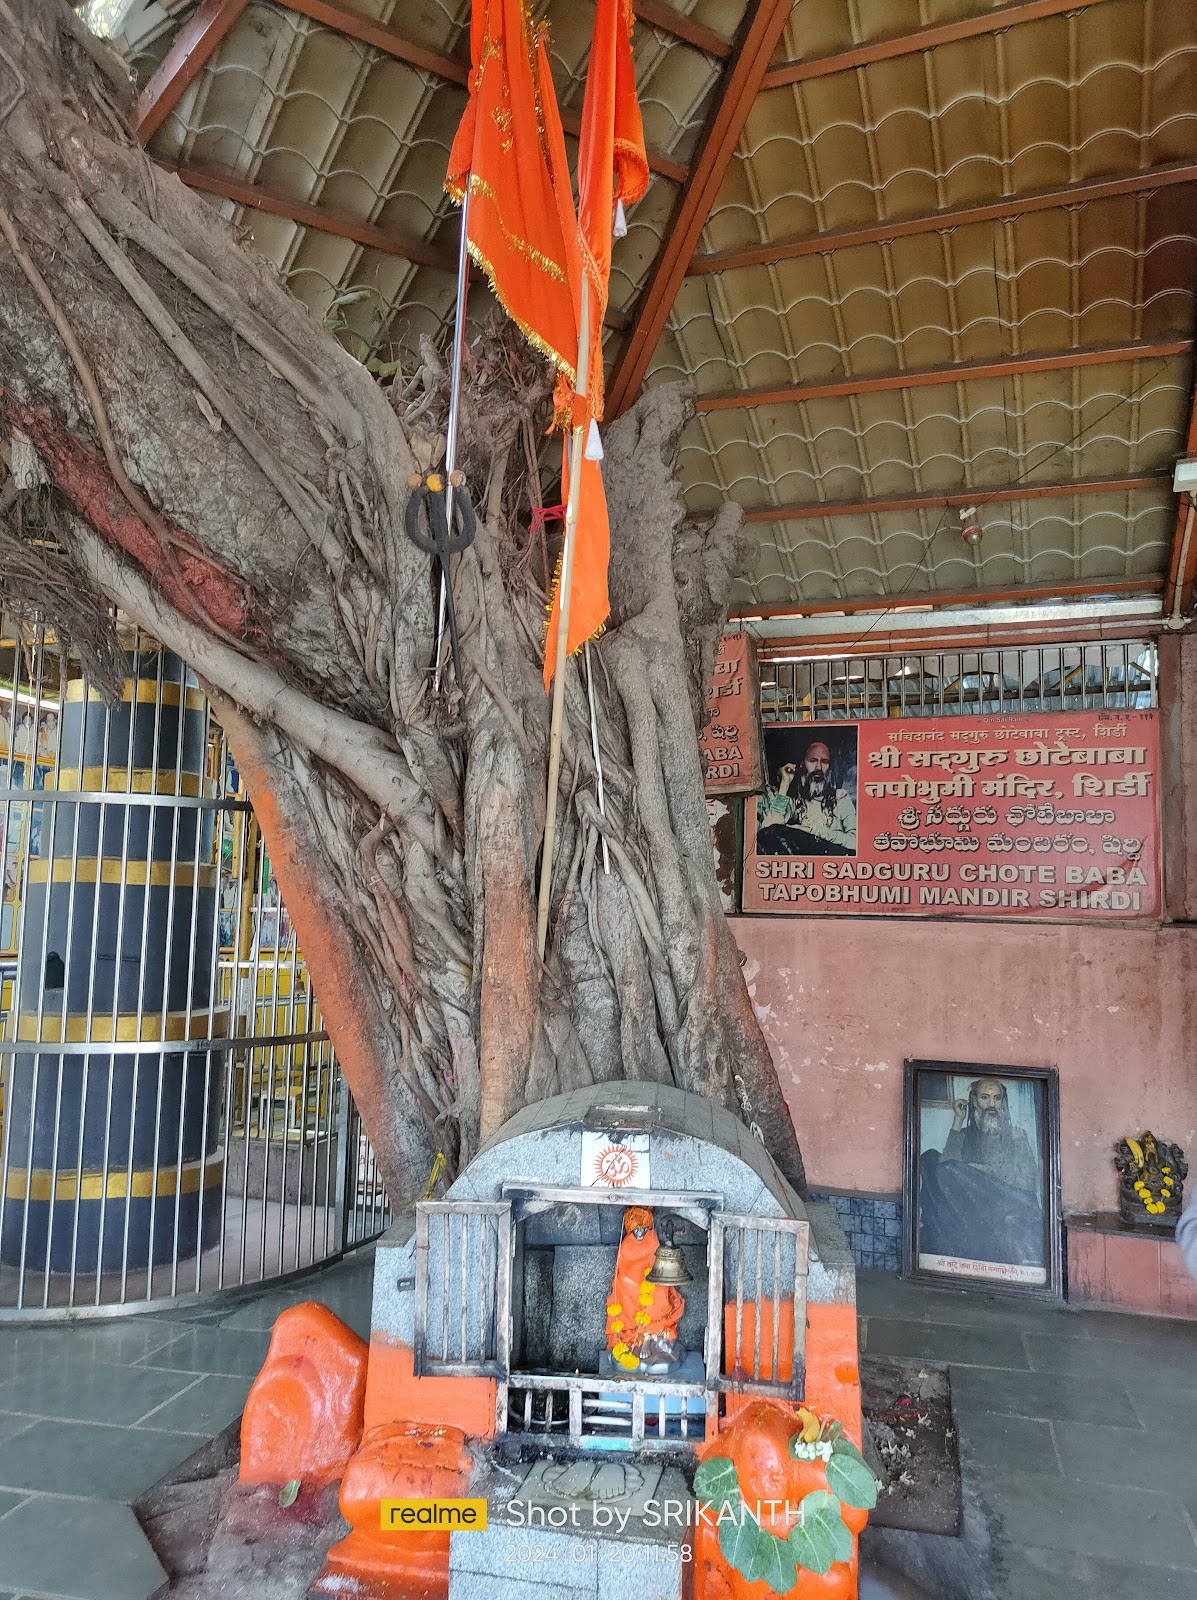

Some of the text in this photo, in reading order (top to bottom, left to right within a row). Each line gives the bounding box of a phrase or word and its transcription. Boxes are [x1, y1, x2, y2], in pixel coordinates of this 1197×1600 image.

[949, 729, 989, 744] सद्गुरु
[993, 725, 1049, 741] छोटेबाबा
[1093, 722, 1128, 739] शिर्डी
[704, 745, 744, 762] ABA
[867, 741, 1147, 774] श्री सद्गुरु छोटेबाबा
[981, 772, 1064, 799] मंदिर,
[1071, 771, 1153, 798] शिर्डी
[755, 861, 1149, 886] SHRI SADGURU CHOTE BABA
[758, 882, 1142, 911] TAPOBHUMI MANDIR SHIRDI
